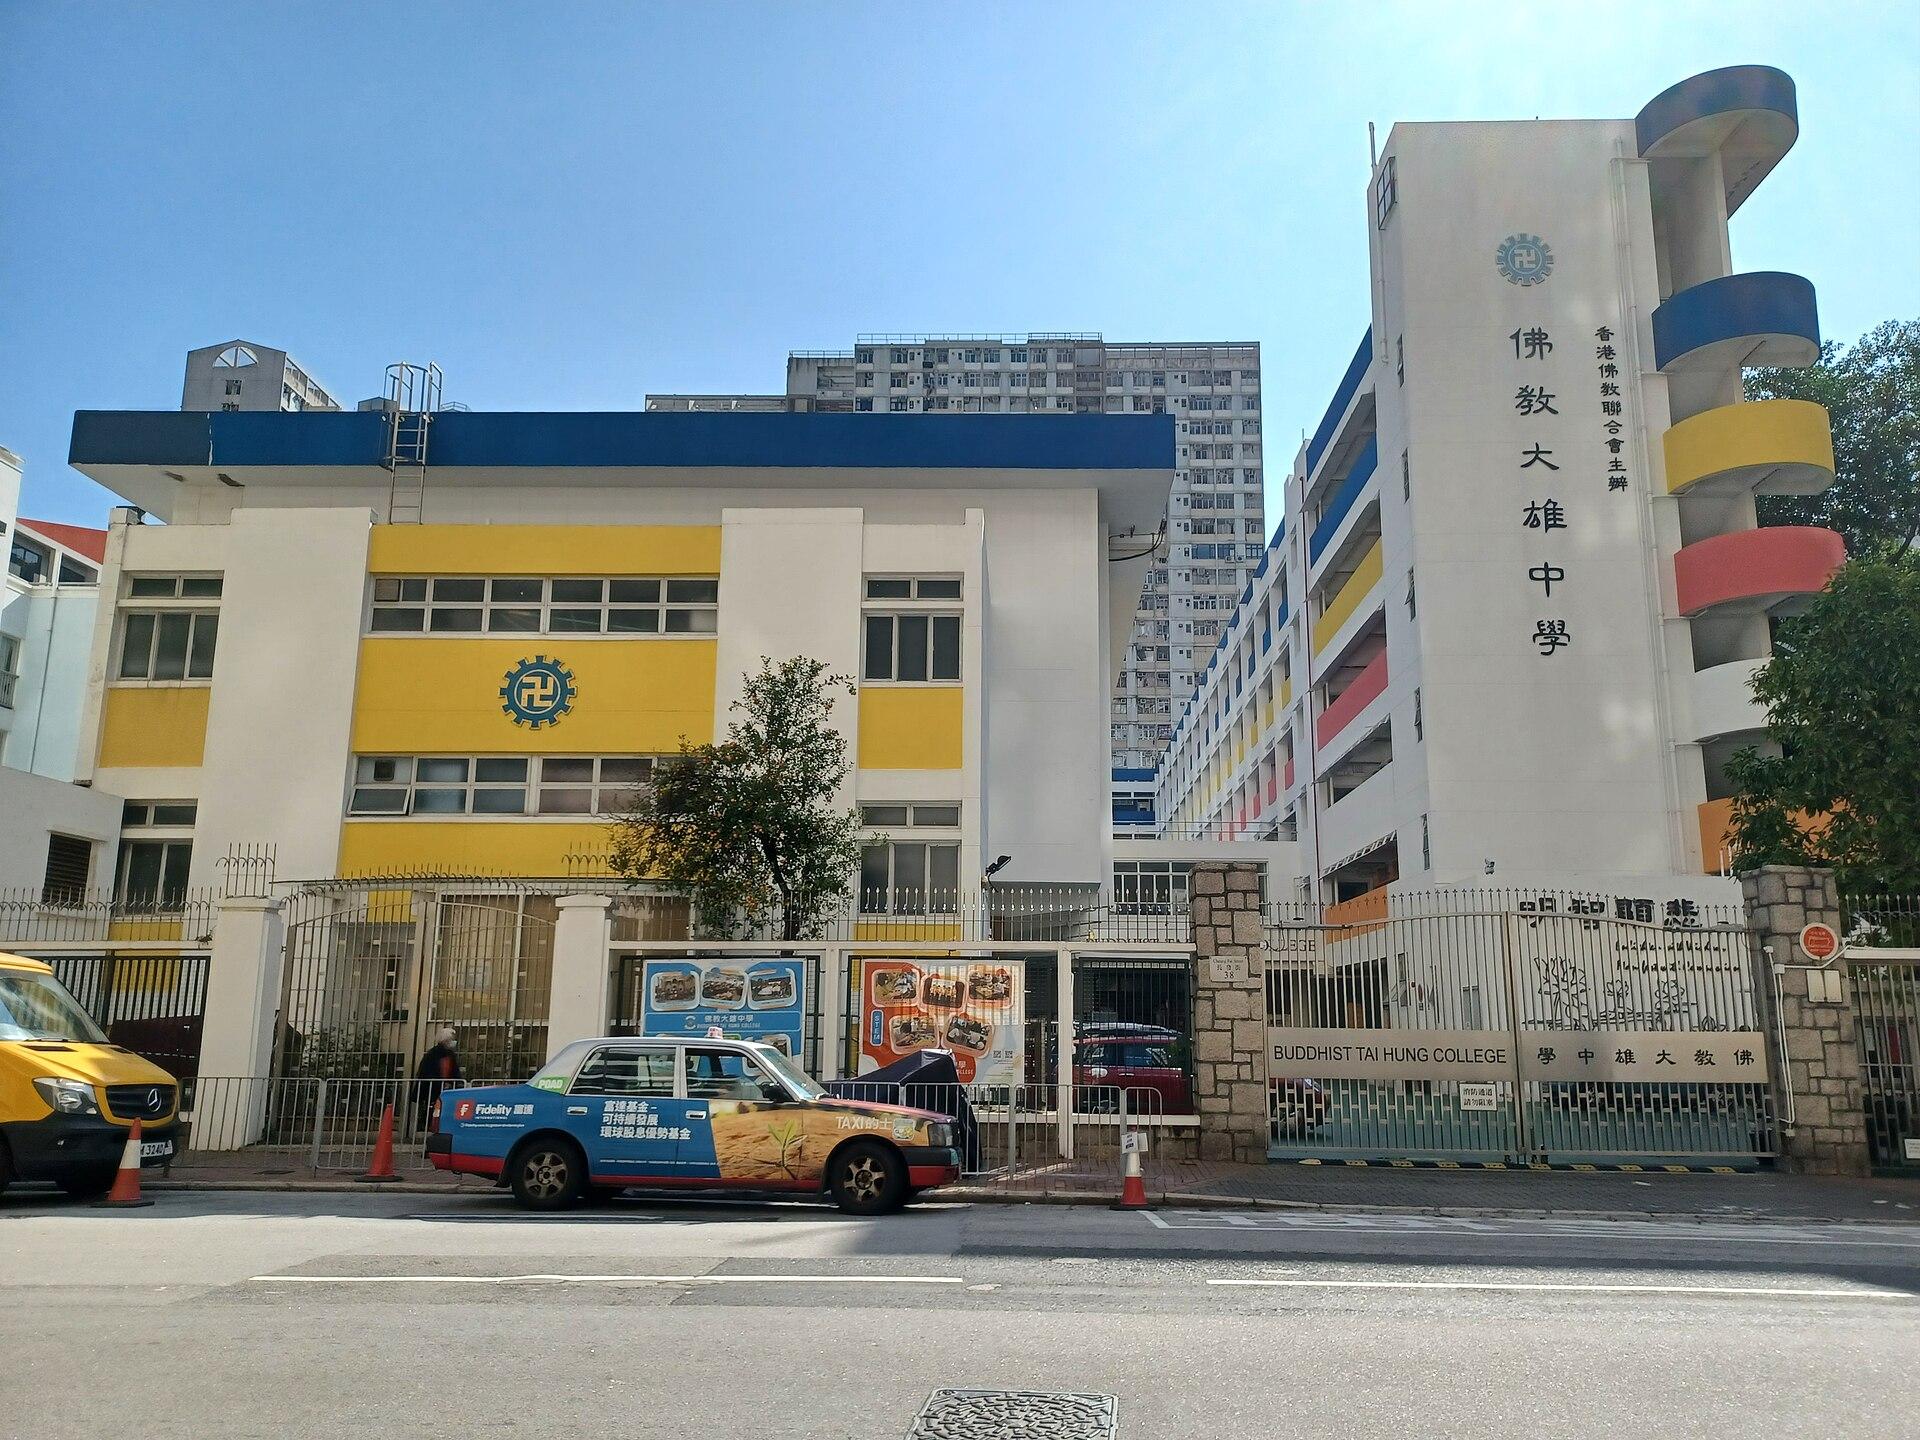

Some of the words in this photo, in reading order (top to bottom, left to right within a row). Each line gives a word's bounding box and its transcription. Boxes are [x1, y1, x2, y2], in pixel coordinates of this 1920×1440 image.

[1595, 325, 1628, 492] 香港佛教聯合會主辦
[1509, 326, 1571, 656] 佛教大雄中學
[1224, 970, 1235, 979] 38
[1274, 1045, 1352, 1061] BUDDHIST
[1355, 1046, 1379, 1061] TAI
[1383, 1047, 1429, 1063] HUNG
[1433, 1048, 1507, 1064] COLLEGE
[475, 1103, 513, 1116] Fidelity
[602, 1113, 659, 1126] 可持續發展
